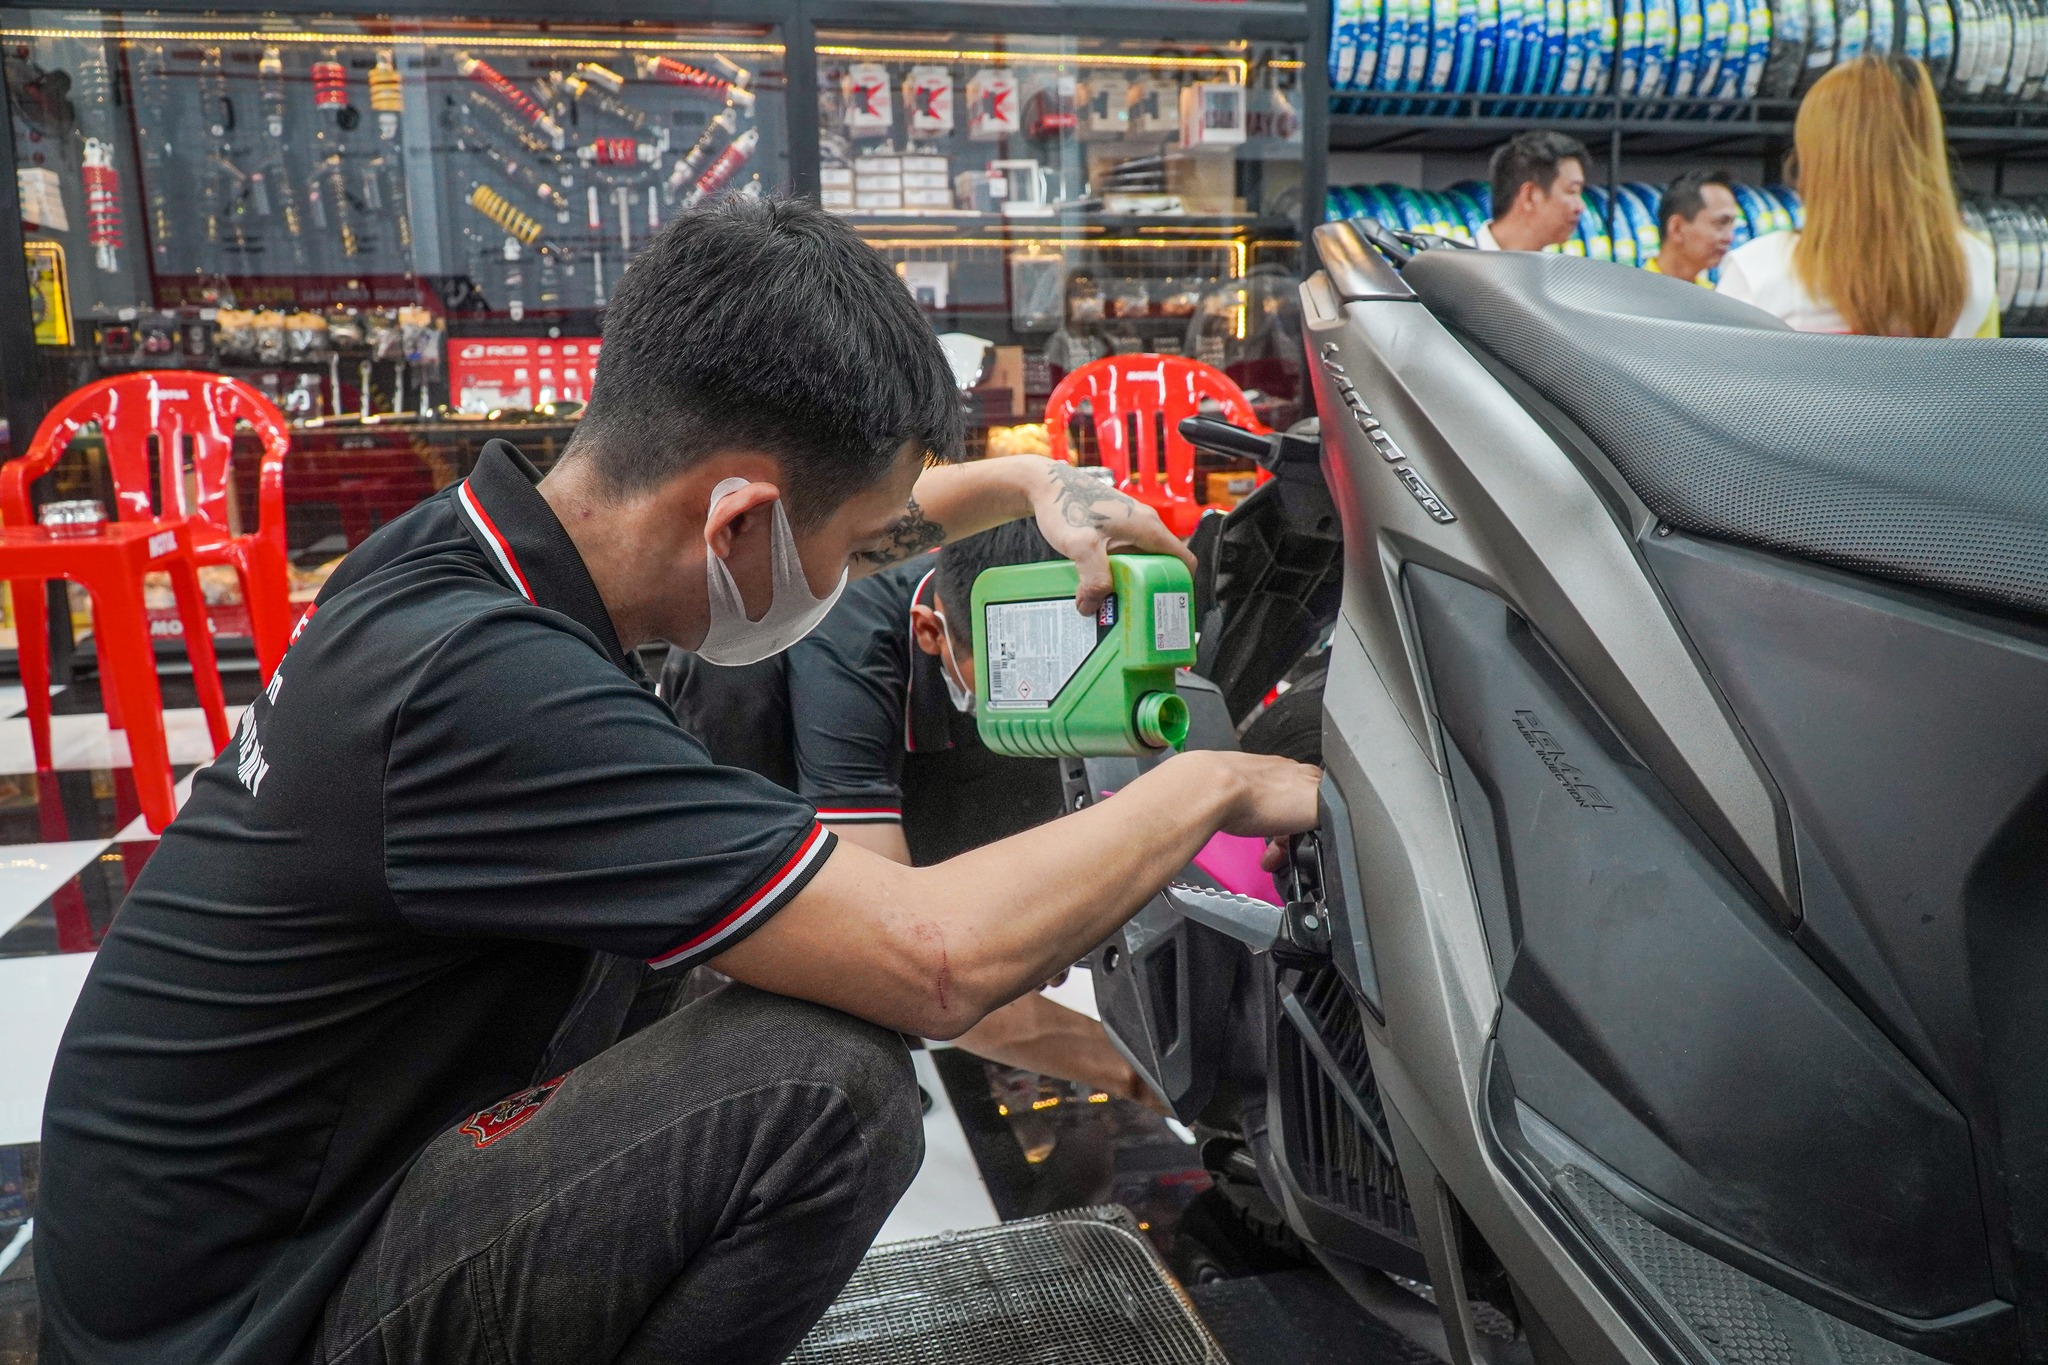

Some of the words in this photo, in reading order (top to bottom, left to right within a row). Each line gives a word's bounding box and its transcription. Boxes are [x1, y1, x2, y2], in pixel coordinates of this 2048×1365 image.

[1321, 342, 1407, 464] VARIO
[1512, 719, 1537, 748] FUEL
[1536, 750, 1590, 808] INJECTION
